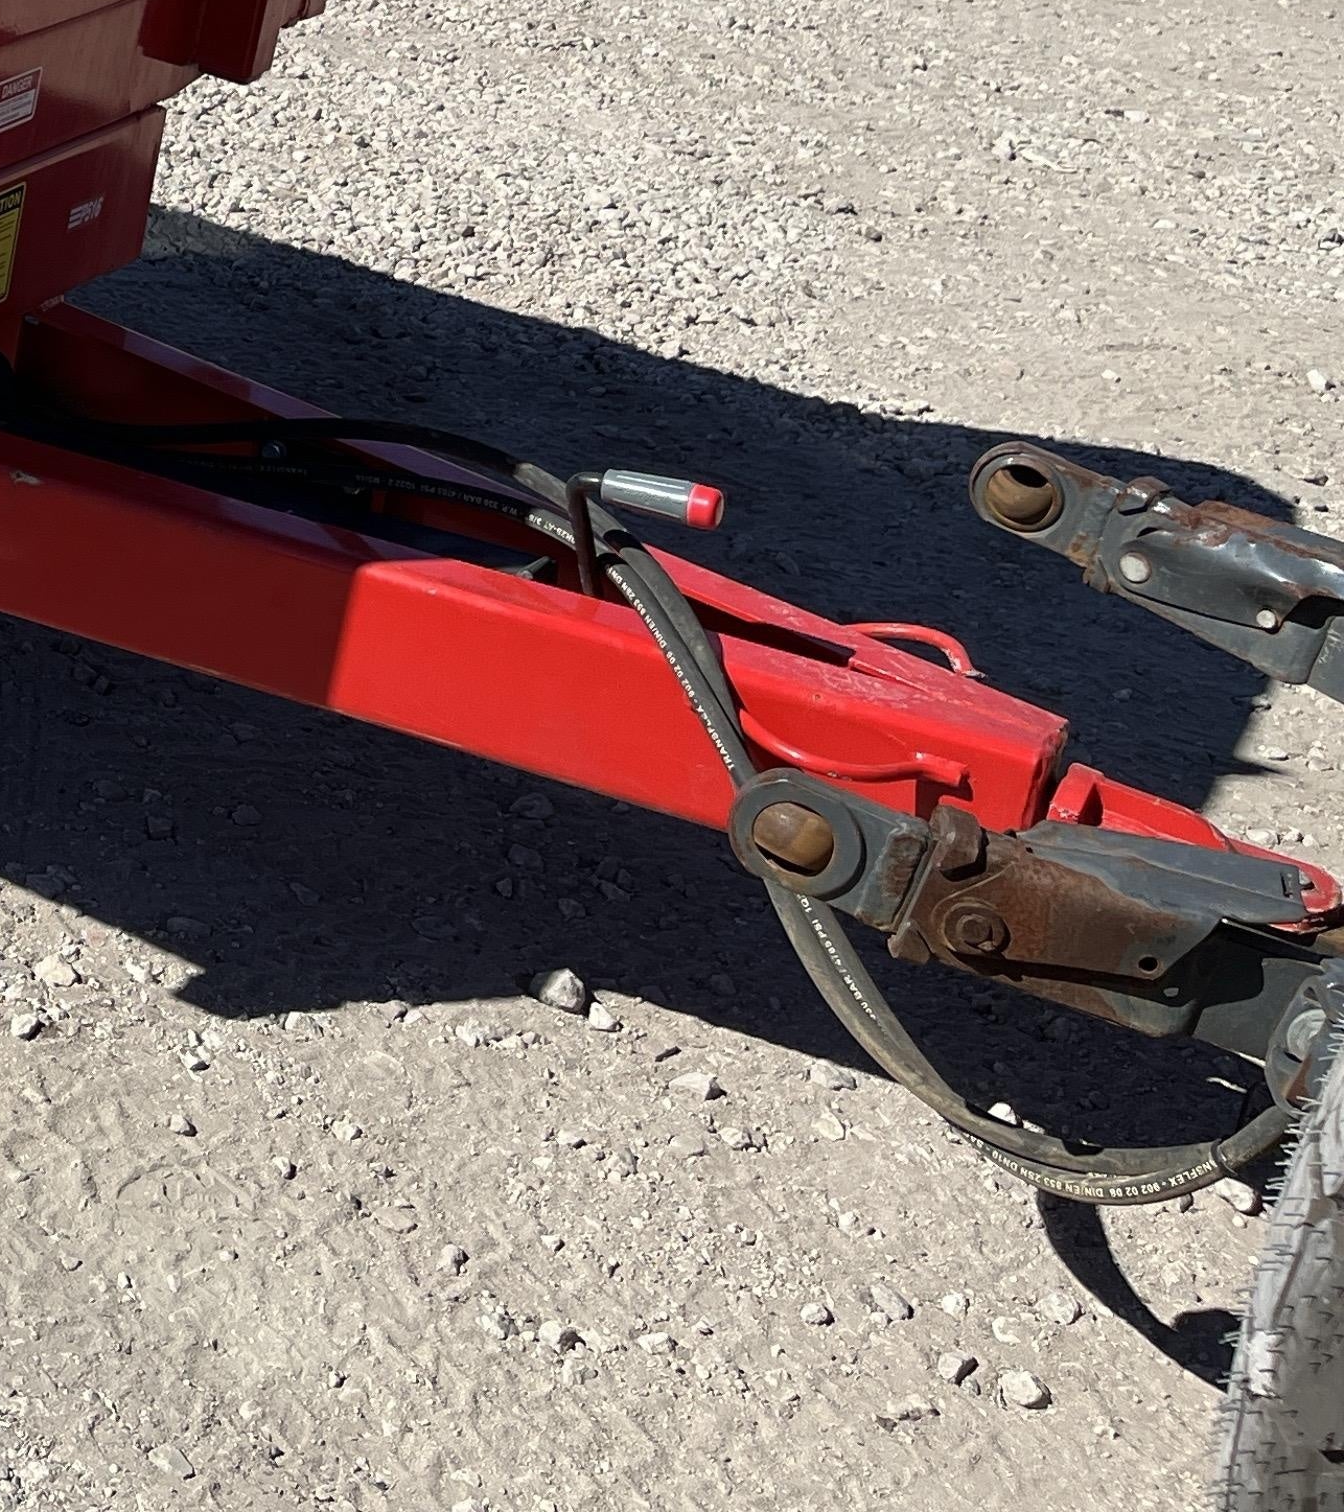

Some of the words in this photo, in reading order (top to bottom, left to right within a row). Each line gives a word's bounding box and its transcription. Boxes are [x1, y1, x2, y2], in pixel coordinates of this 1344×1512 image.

[1, 75, 33, 99] DANGER
[607, 566, 622, 585] DN1
[643, 615, 668, 649] DIN/EN
[695, 705, 735, 771] TRANSFLEX
[811, 918, 828, 940] PSI
[843, 973, 862, 1001] BAR
[991, 1150, 1020, 1171] DN10
[1043, 1177, 1063, 1191] 853
